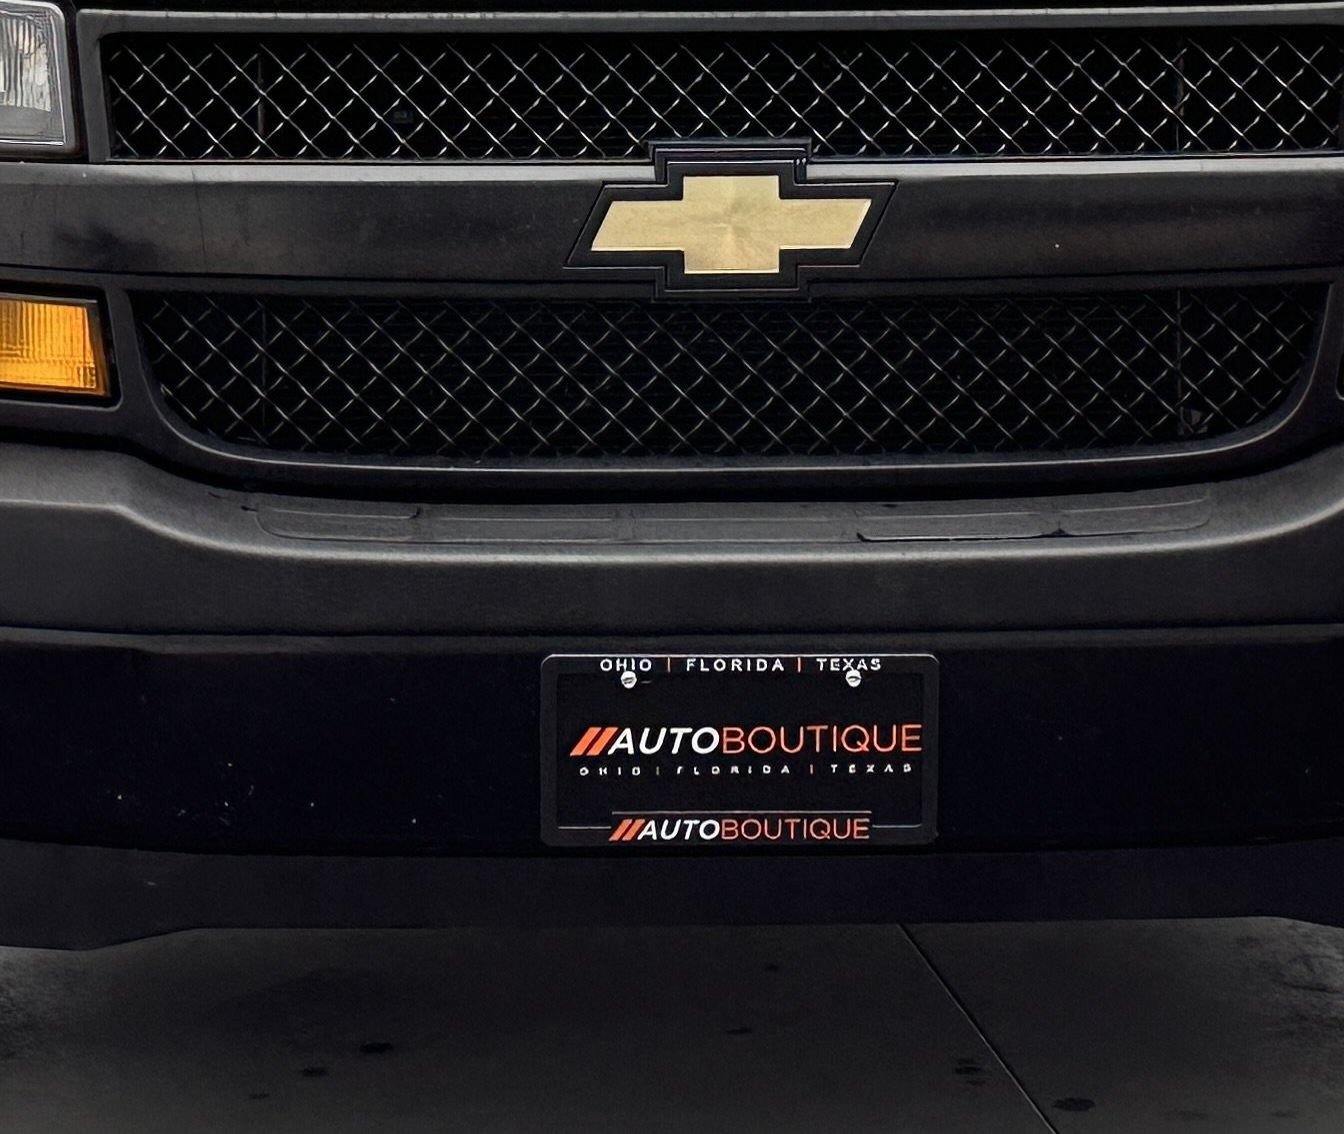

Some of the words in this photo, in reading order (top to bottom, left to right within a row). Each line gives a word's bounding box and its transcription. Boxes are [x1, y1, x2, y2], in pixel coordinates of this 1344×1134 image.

[600, 658, 652, 671] OHIO
[686, 658, 784, 671] FLORIDA
[816, 658, 882, 671] TEXAS
[579, 767, 641, 776] OHIO
[676, 766, 790, 775] FLORIDA
[830, 764, 912, 773] TEXAS
